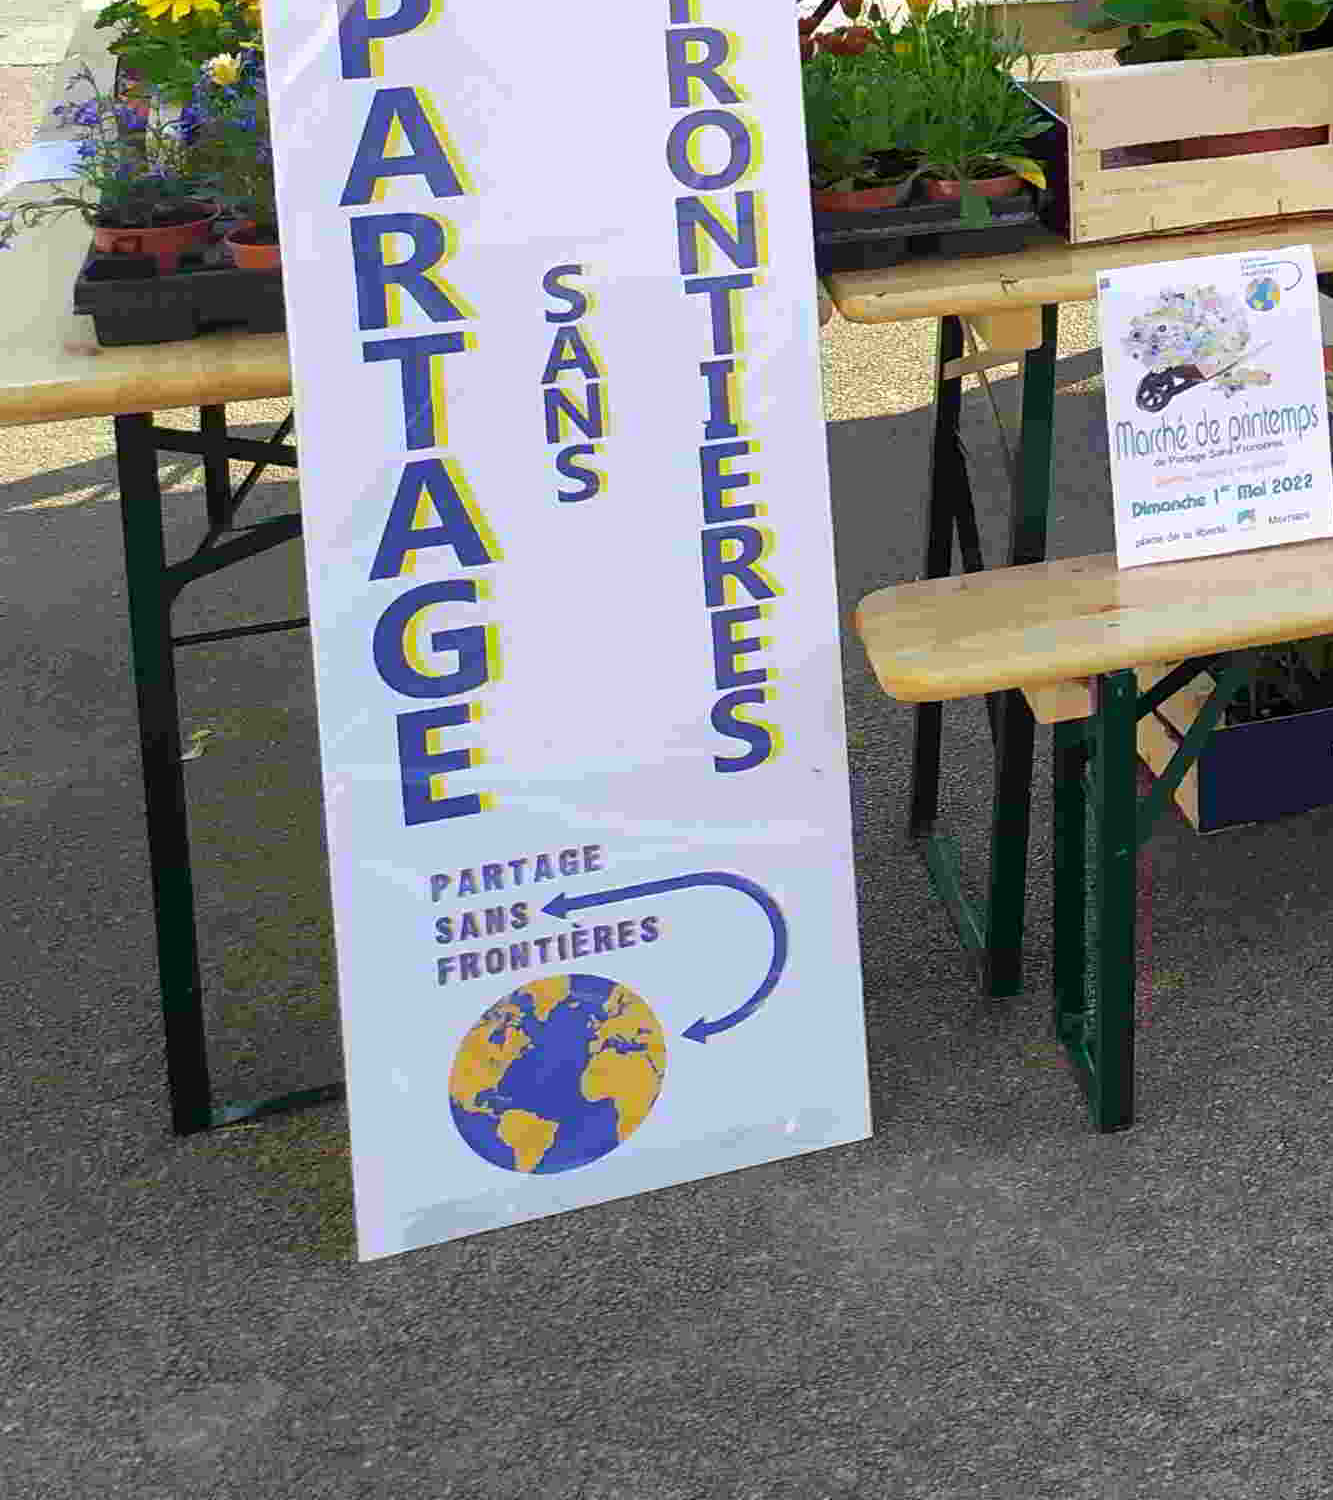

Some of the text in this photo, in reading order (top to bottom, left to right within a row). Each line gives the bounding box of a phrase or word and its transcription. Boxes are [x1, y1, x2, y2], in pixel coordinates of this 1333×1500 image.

[540, 263, 614, 504] SANS
[1115, 402, 1319, 460] Marché de printemps
[1132, 491, 1207, 518] Dimanche
[1238, 480, 1267, 499] Mai
[1272, 473, 1313, 493] 2022
[429, 844, 602, 903] PARTAGE
[435, 901, 530, 945] SANS
[436, 915, 661, 987] FRONTIÈRES
